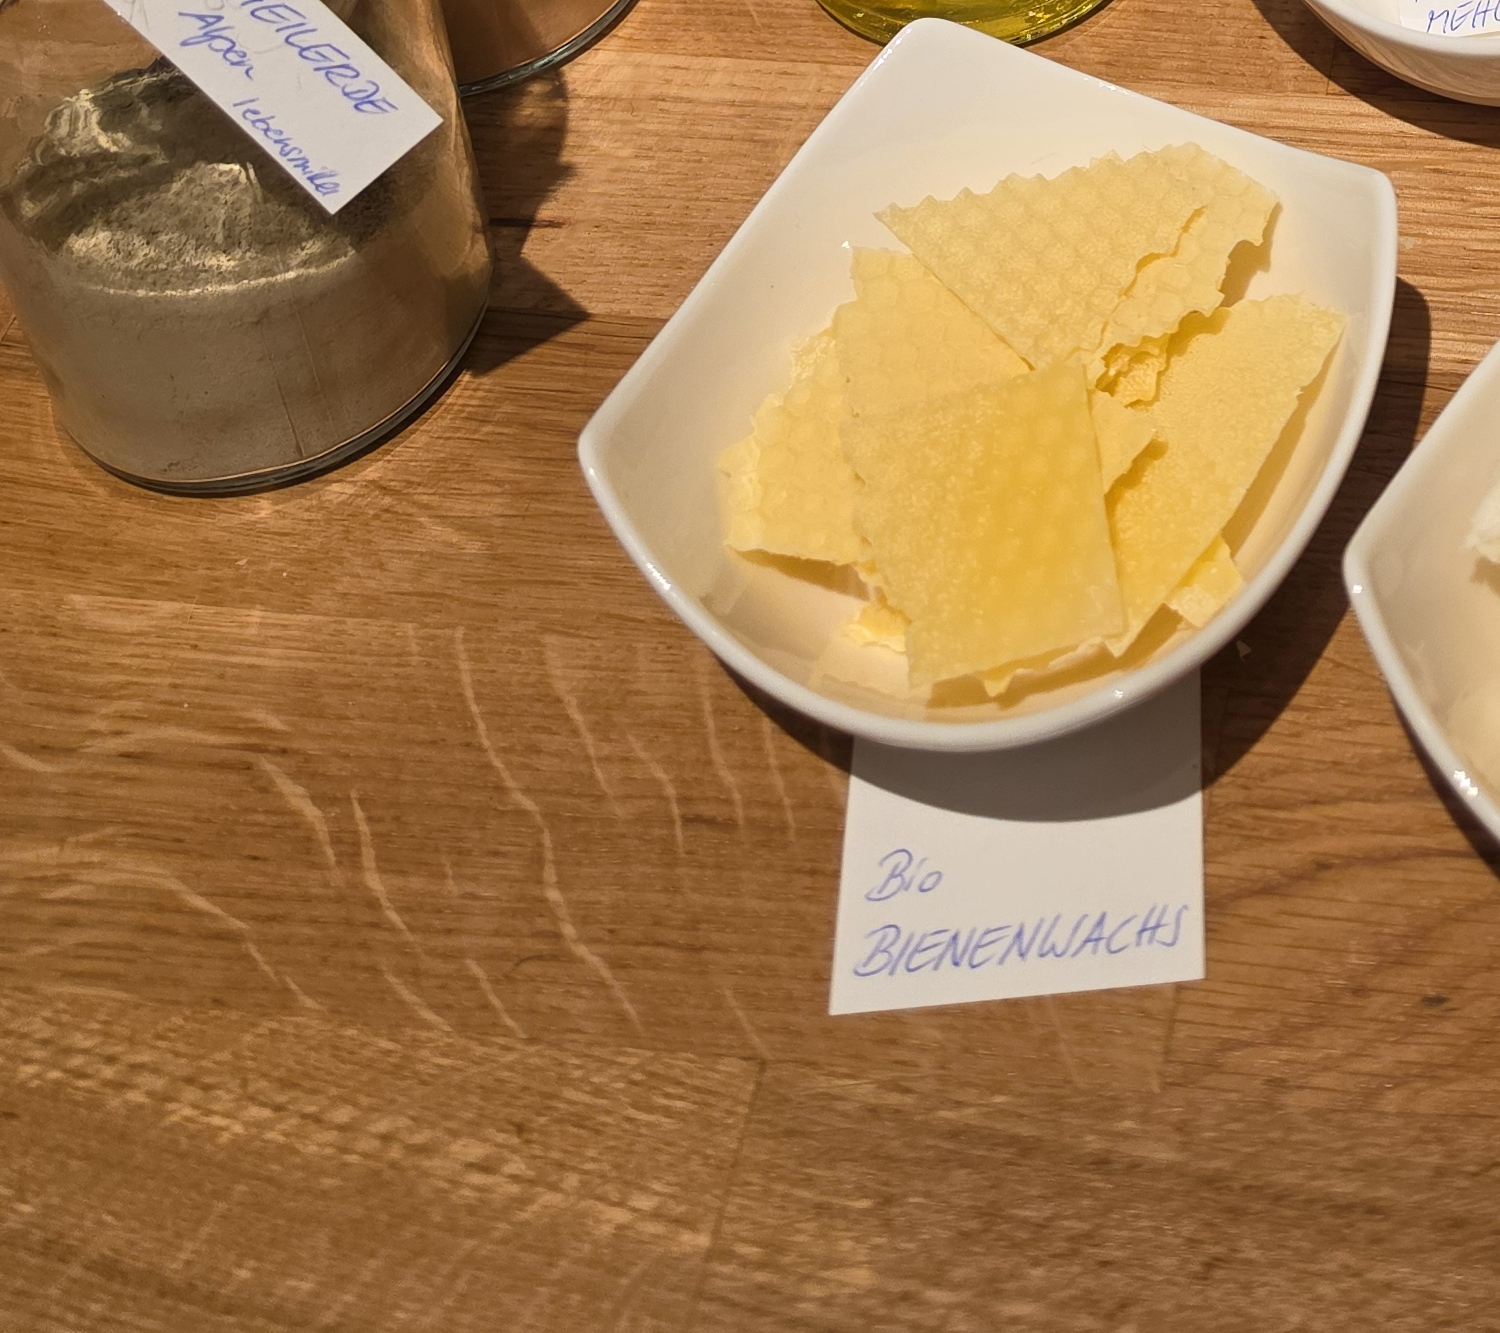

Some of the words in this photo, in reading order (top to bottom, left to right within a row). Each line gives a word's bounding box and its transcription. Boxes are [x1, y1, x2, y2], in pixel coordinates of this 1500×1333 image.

[177, 11, 255, 82] Alpen
[864, 847, 945, 902] Bio
[852, 901, 1190, 977] BIENENWACHS
